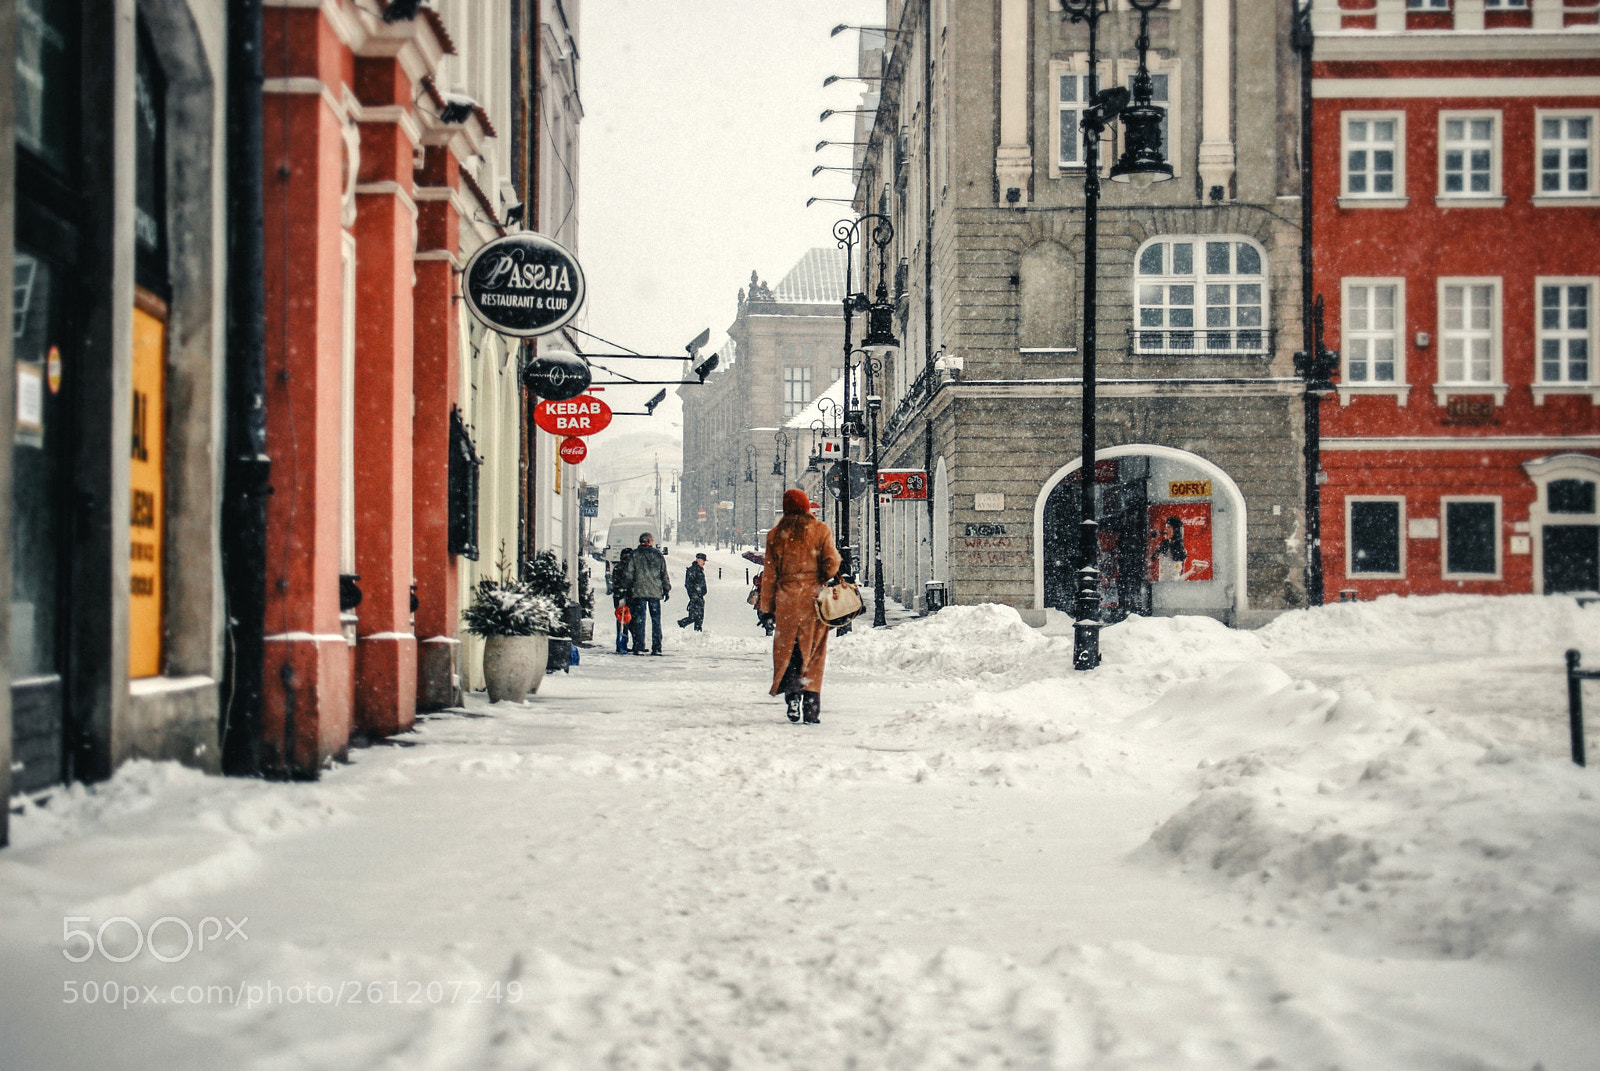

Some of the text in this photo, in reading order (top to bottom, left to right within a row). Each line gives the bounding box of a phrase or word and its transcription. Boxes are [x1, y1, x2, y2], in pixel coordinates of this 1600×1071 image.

[481, 293, 568, 310] RESTAURANT & CLUB
[545, 402, 601, 415] KEBAB
[556, 417, 591, 429] BAR
[1171, 482, 1207, 495] GOFRY
